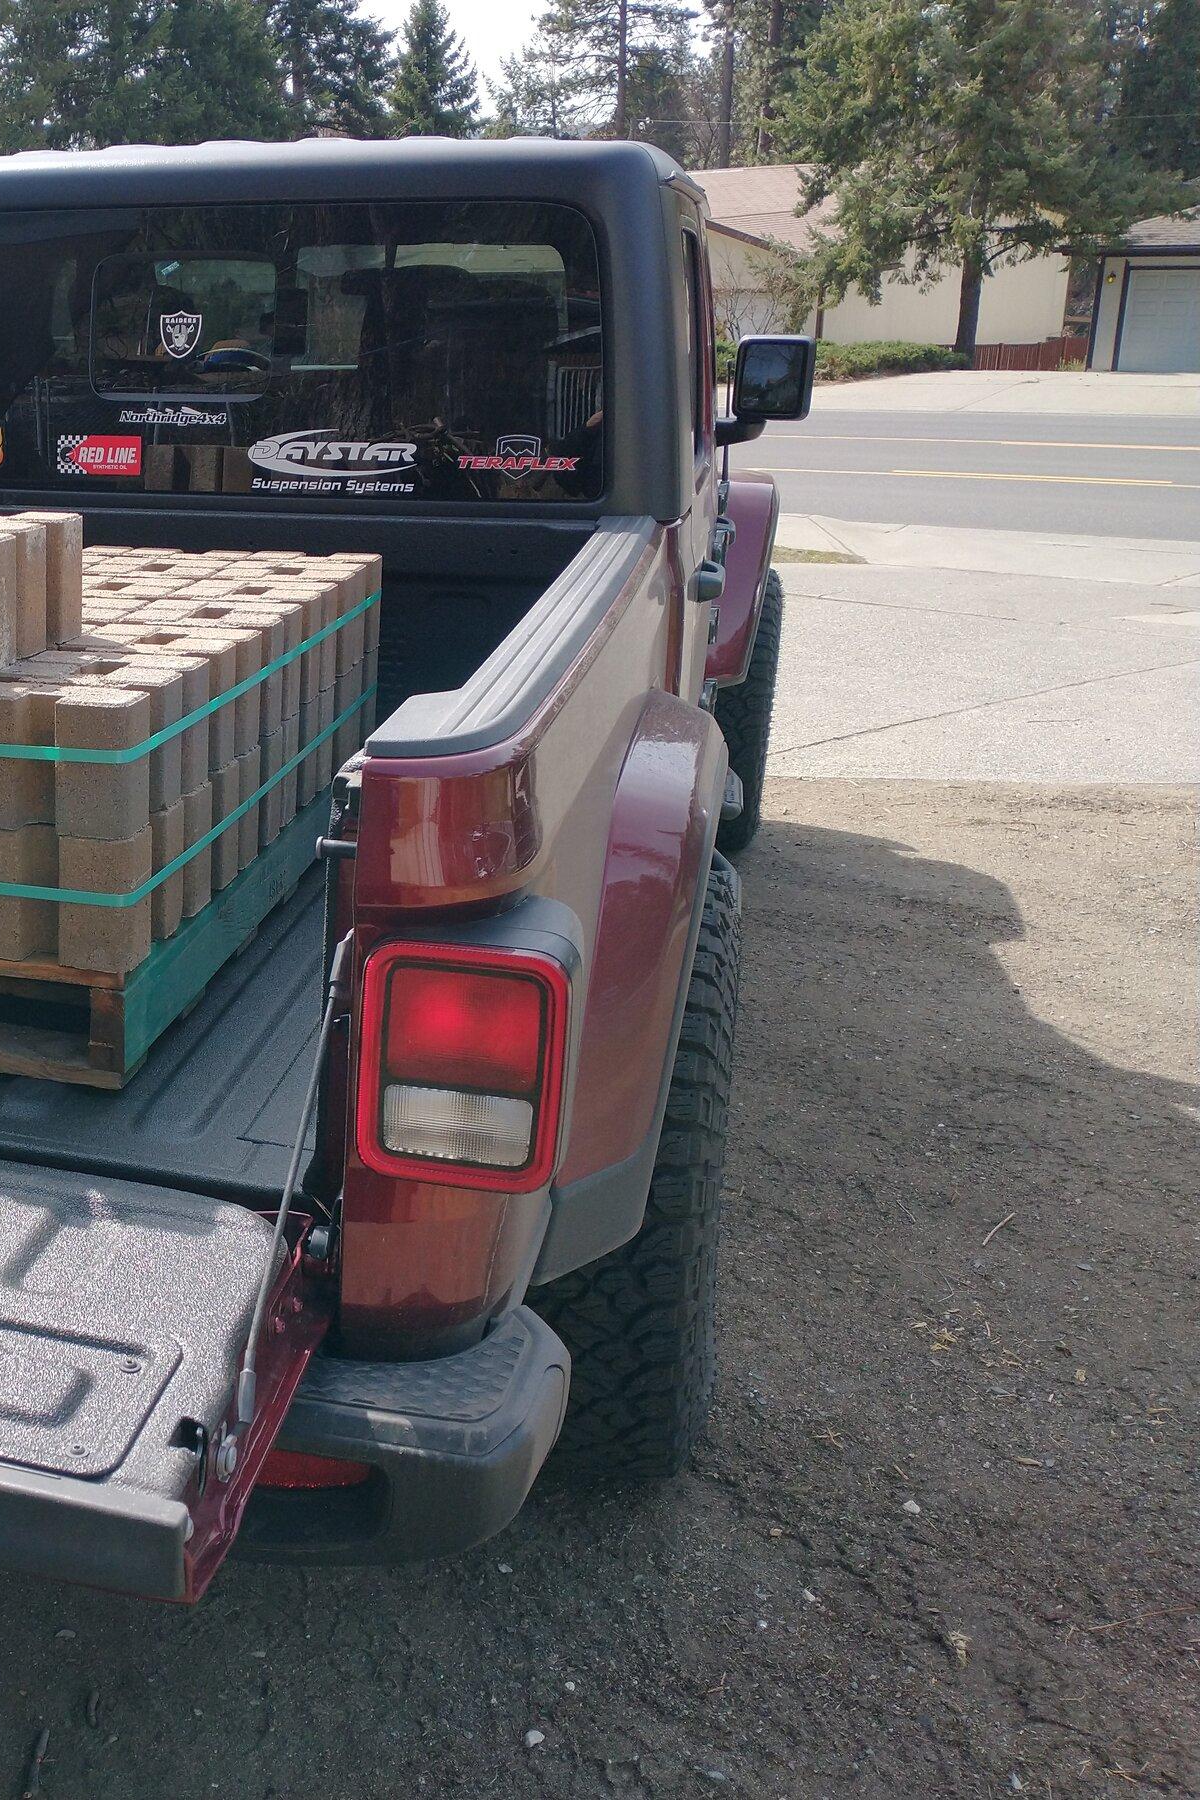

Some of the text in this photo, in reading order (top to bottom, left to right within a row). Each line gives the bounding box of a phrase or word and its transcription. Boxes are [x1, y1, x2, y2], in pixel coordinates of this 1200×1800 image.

[119, 409, 227, 427] Northridge4x4
[78, 447, 104, 463] RED
[252, 441, 418, 462] DAYSTAR
[458, 456, 580, 470] TERAFLEX
[251, 478, 414, 493] Suspension Systems
